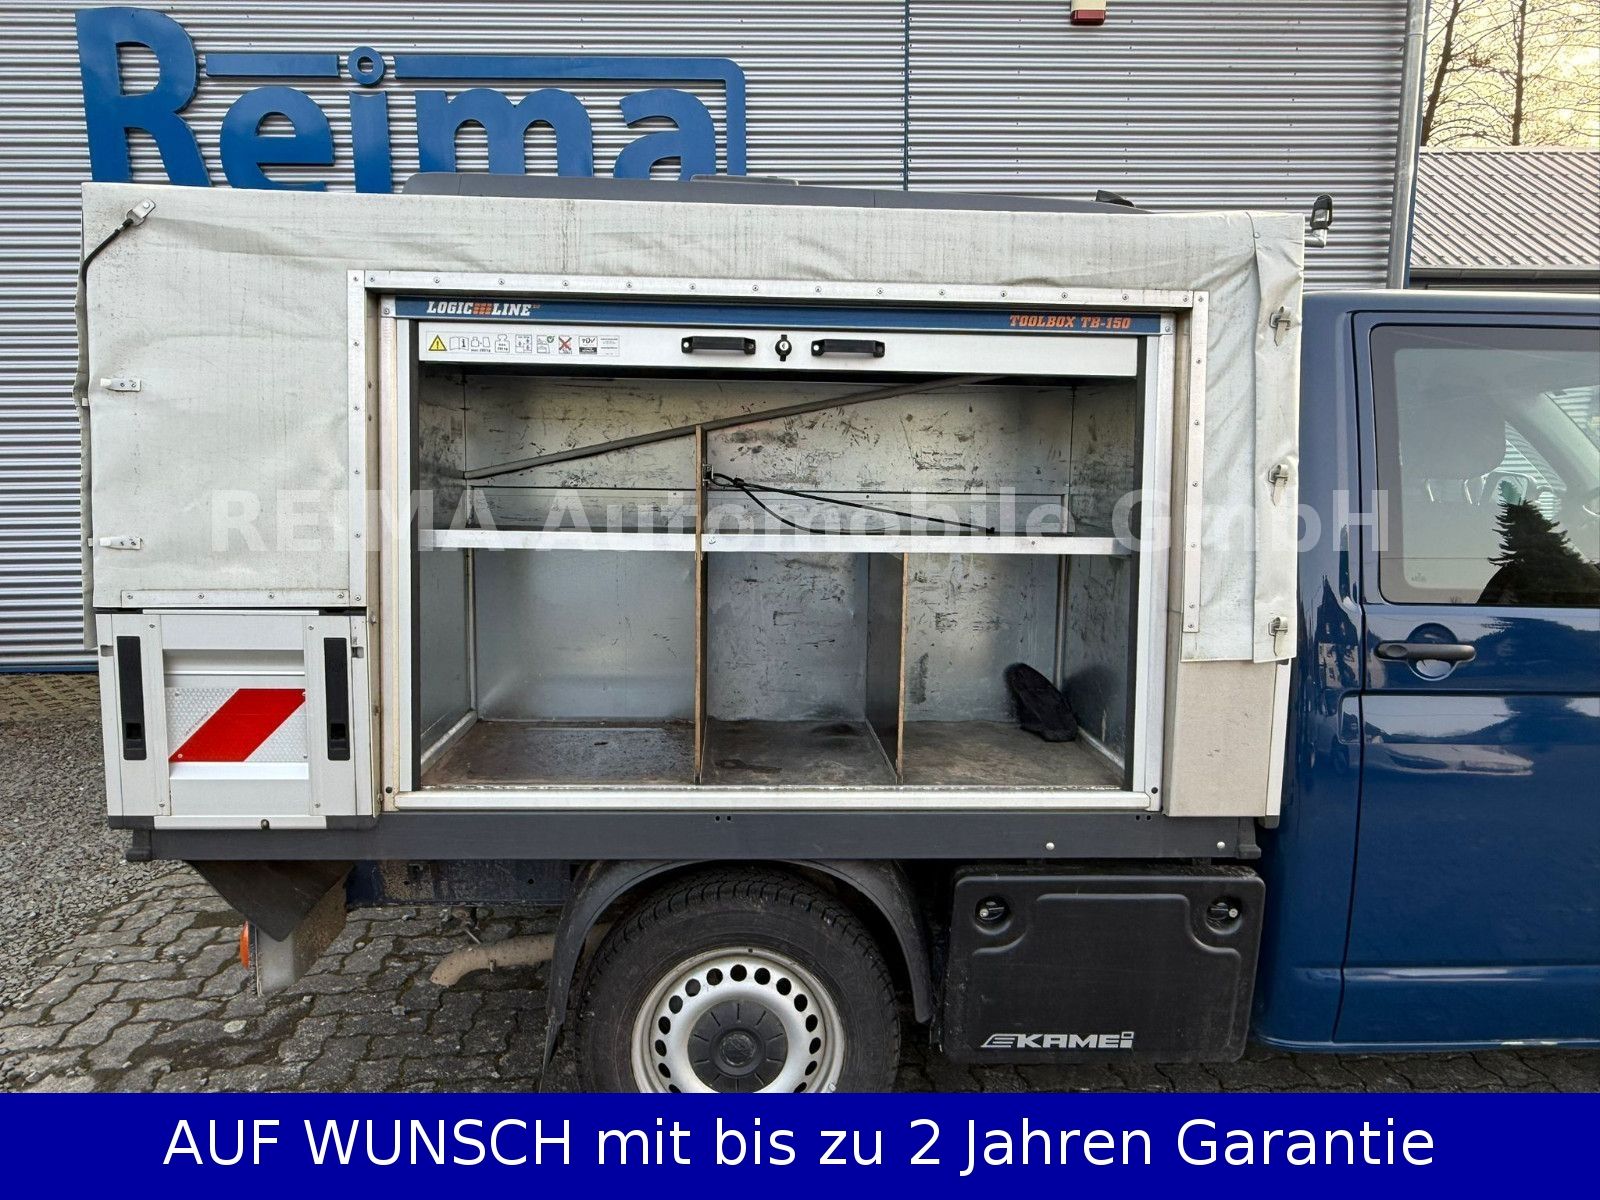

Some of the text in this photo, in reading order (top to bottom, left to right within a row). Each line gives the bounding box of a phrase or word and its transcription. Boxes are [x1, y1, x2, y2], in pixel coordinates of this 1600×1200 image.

[75, 7, 724, 194] Reima
[426, 301, 531, 316] LOGIC LINE
[1009, 315, 1131, 329] TOOLBOX TB-150
